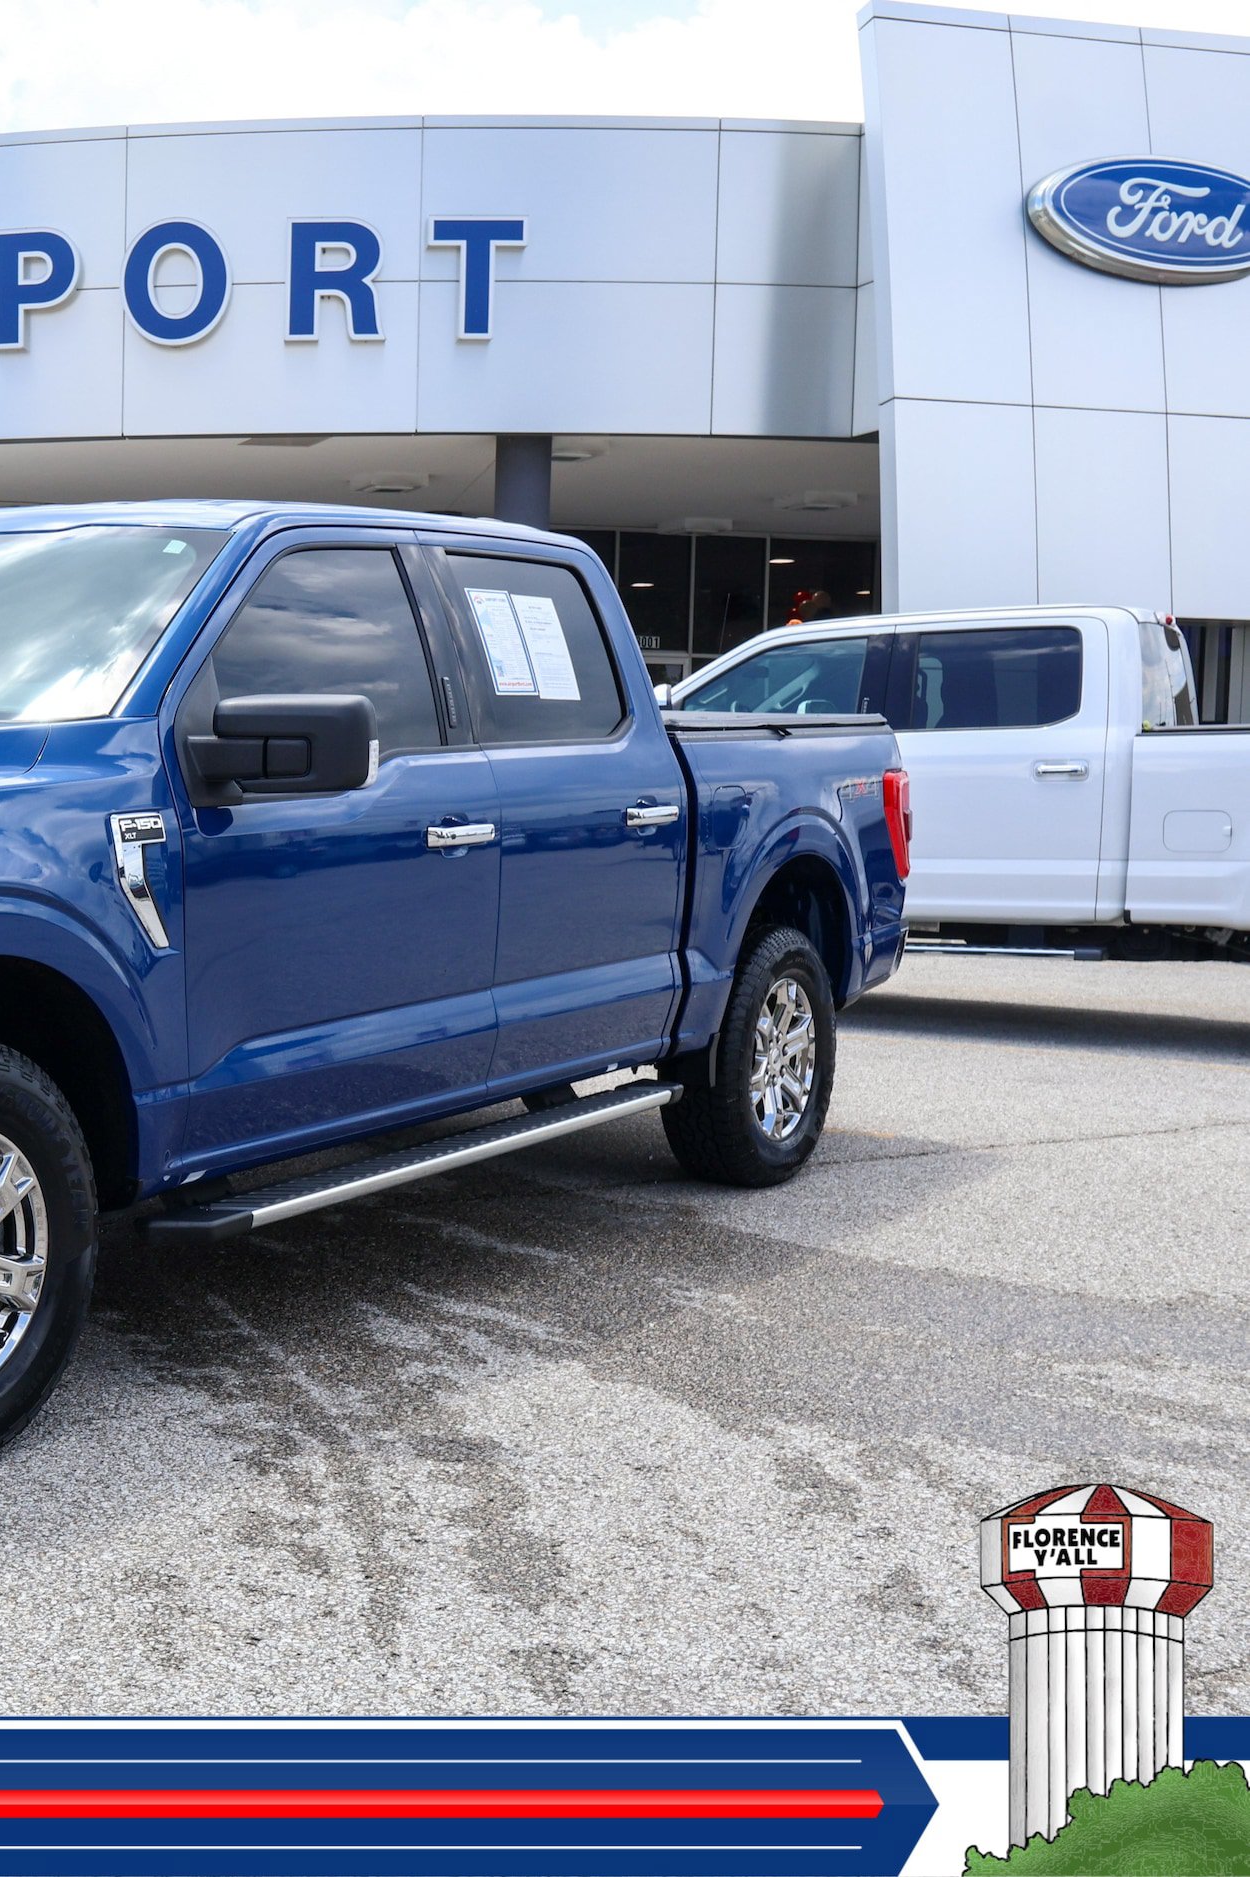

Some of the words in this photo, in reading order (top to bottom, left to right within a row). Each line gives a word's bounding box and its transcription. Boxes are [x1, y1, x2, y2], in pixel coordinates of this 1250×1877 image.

[1106, 176, 1246, 249] Ford
[637, 635, 661, 649] 001
[119, 817, 162, 832] F-150
[124, 832, 137, 840] XLT
